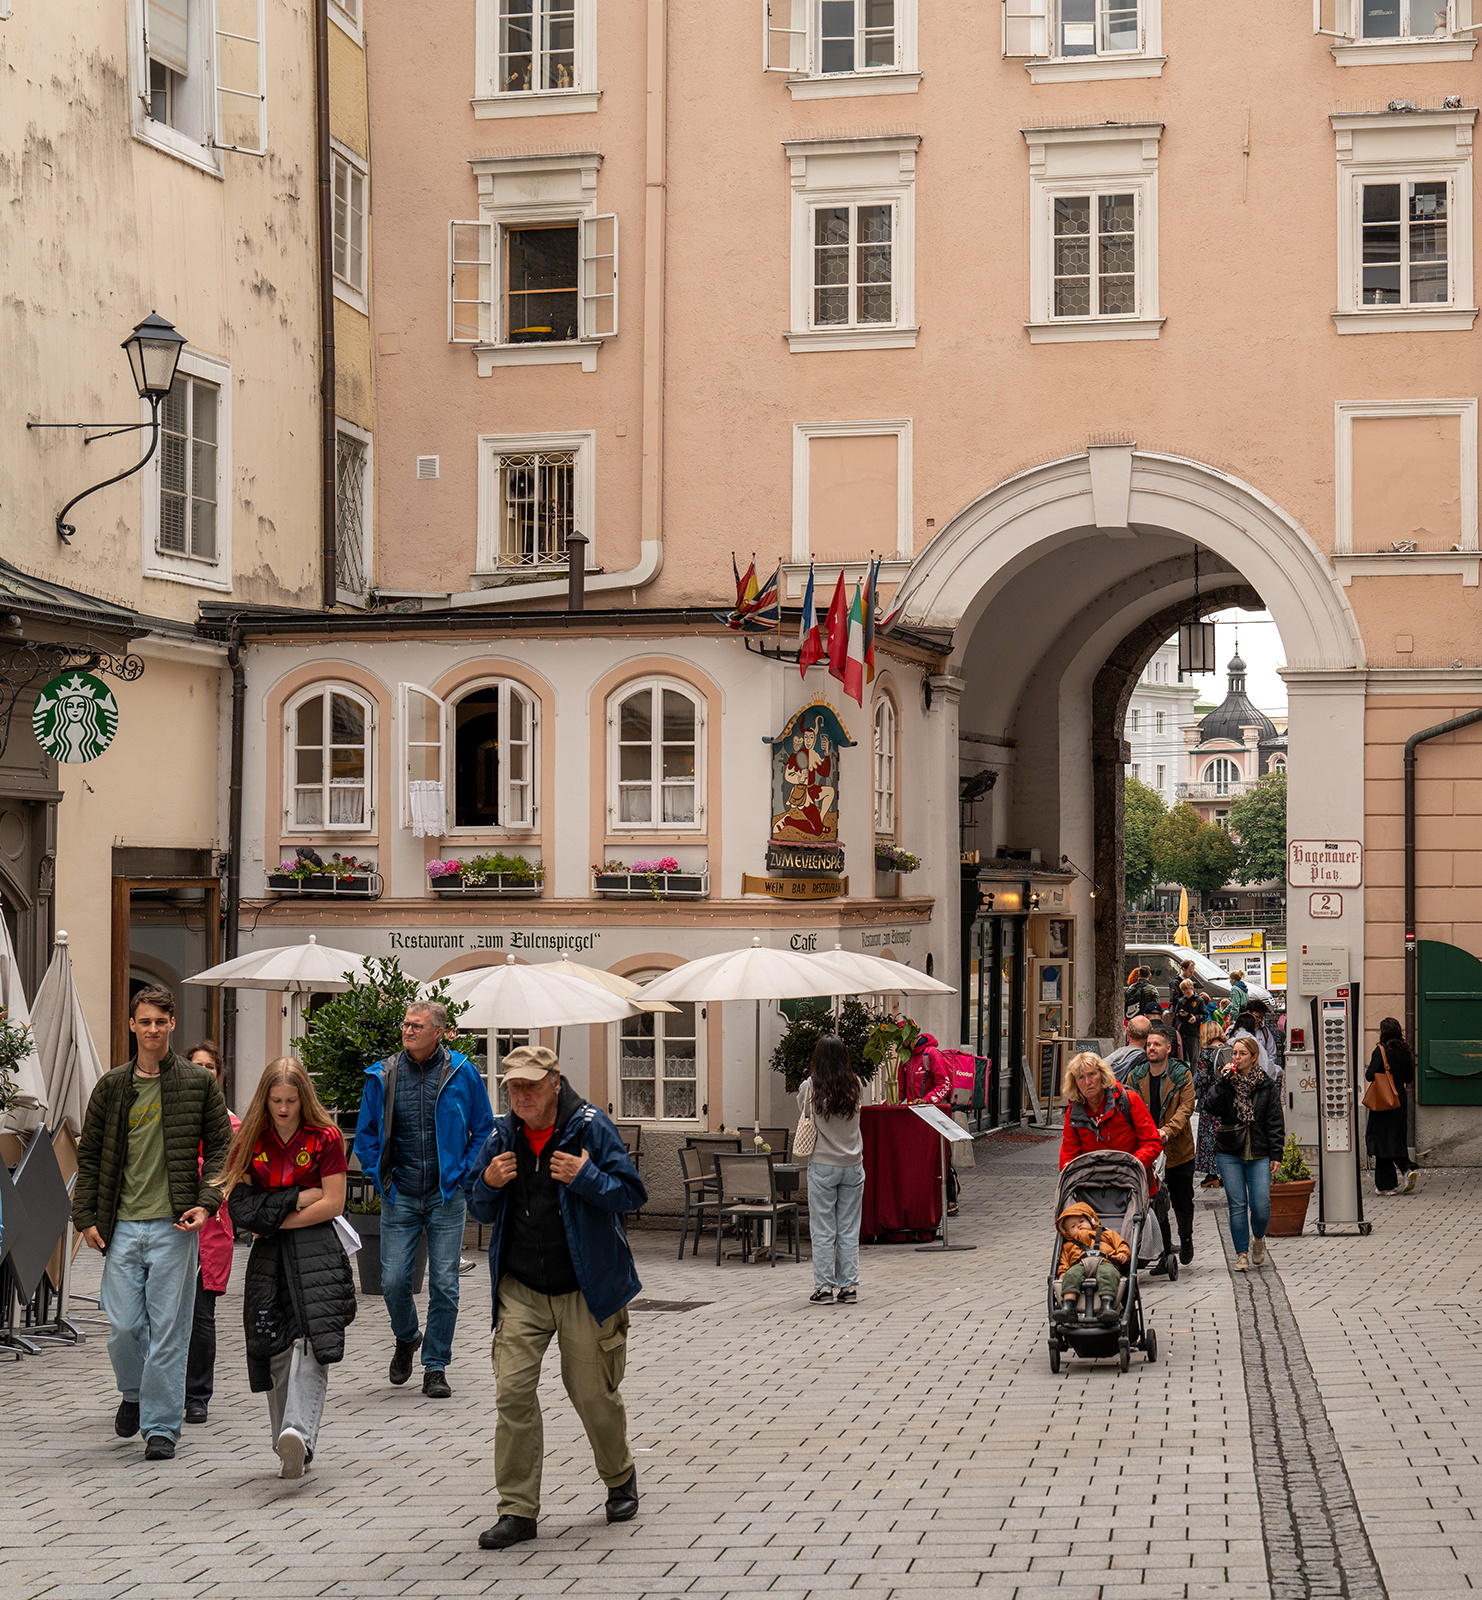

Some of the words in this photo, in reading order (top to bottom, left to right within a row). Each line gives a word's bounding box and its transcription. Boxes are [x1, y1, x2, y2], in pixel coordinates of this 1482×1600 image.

[1292, 845, 1359, 867] Hagenauer-
[765, 882, 784, 893] WEIN
[792, 883, 806, 894] BAR
[1321, 894, 1331, 910] 2
[389, 932, 464, 949] Restaurant
[790, 933, 818, 952] Café
